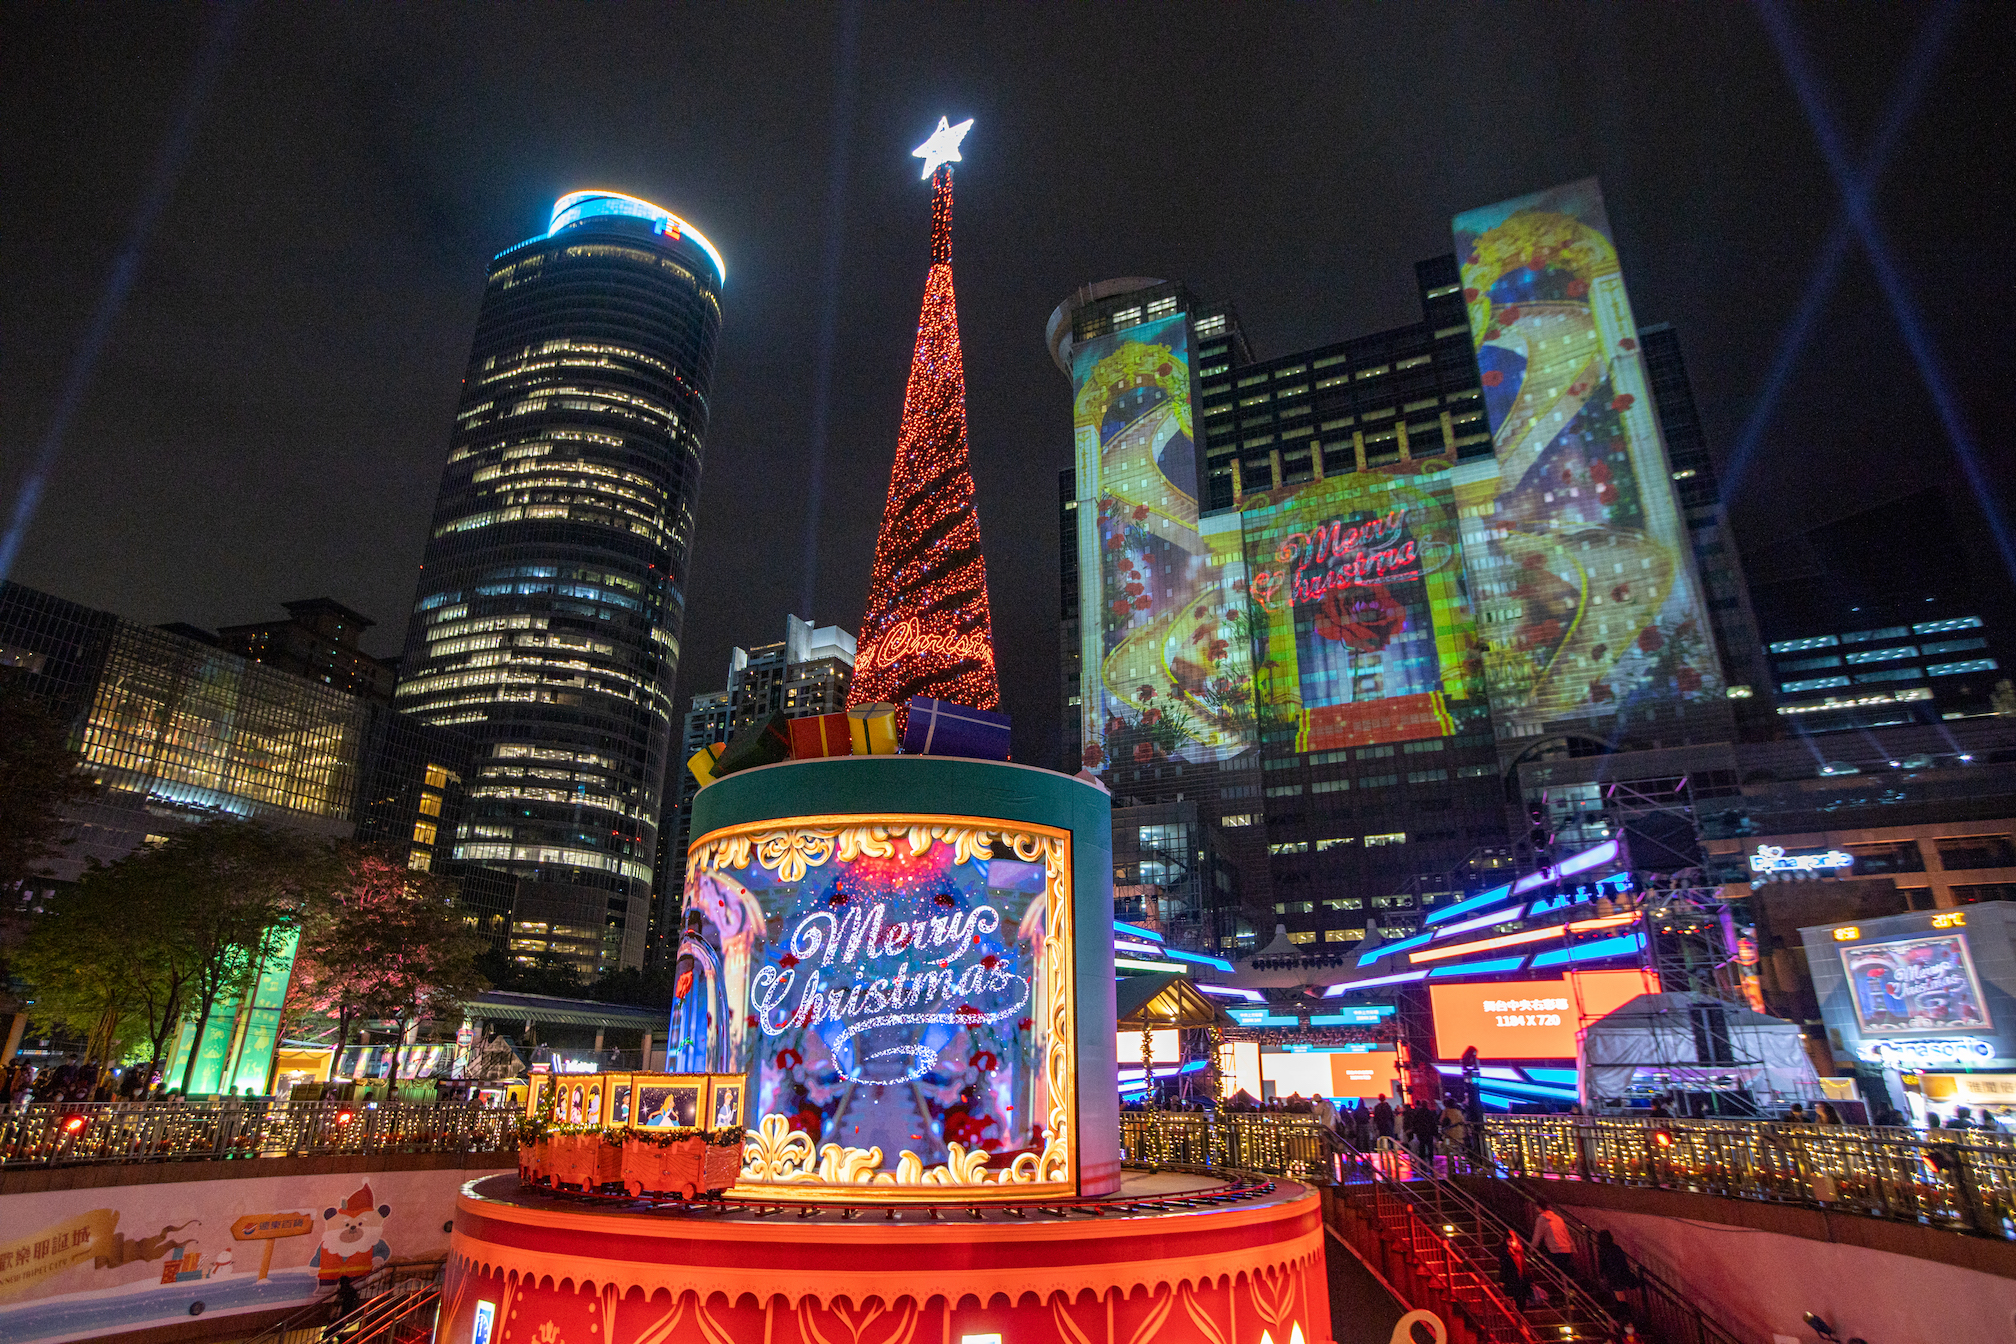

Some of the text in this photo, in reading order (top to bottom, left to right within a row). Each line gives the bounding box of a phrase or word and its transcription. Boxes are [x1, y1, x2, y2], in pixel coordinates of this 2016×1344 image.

[790, 903, 999, 968] Merry
[1893, 961, 1953, 981] Merry
[751, 959, 1024, 1036] Christmas
[1536, 1014, 1561, 1026] 720
[49, 1258, 68, 1271] CITY
